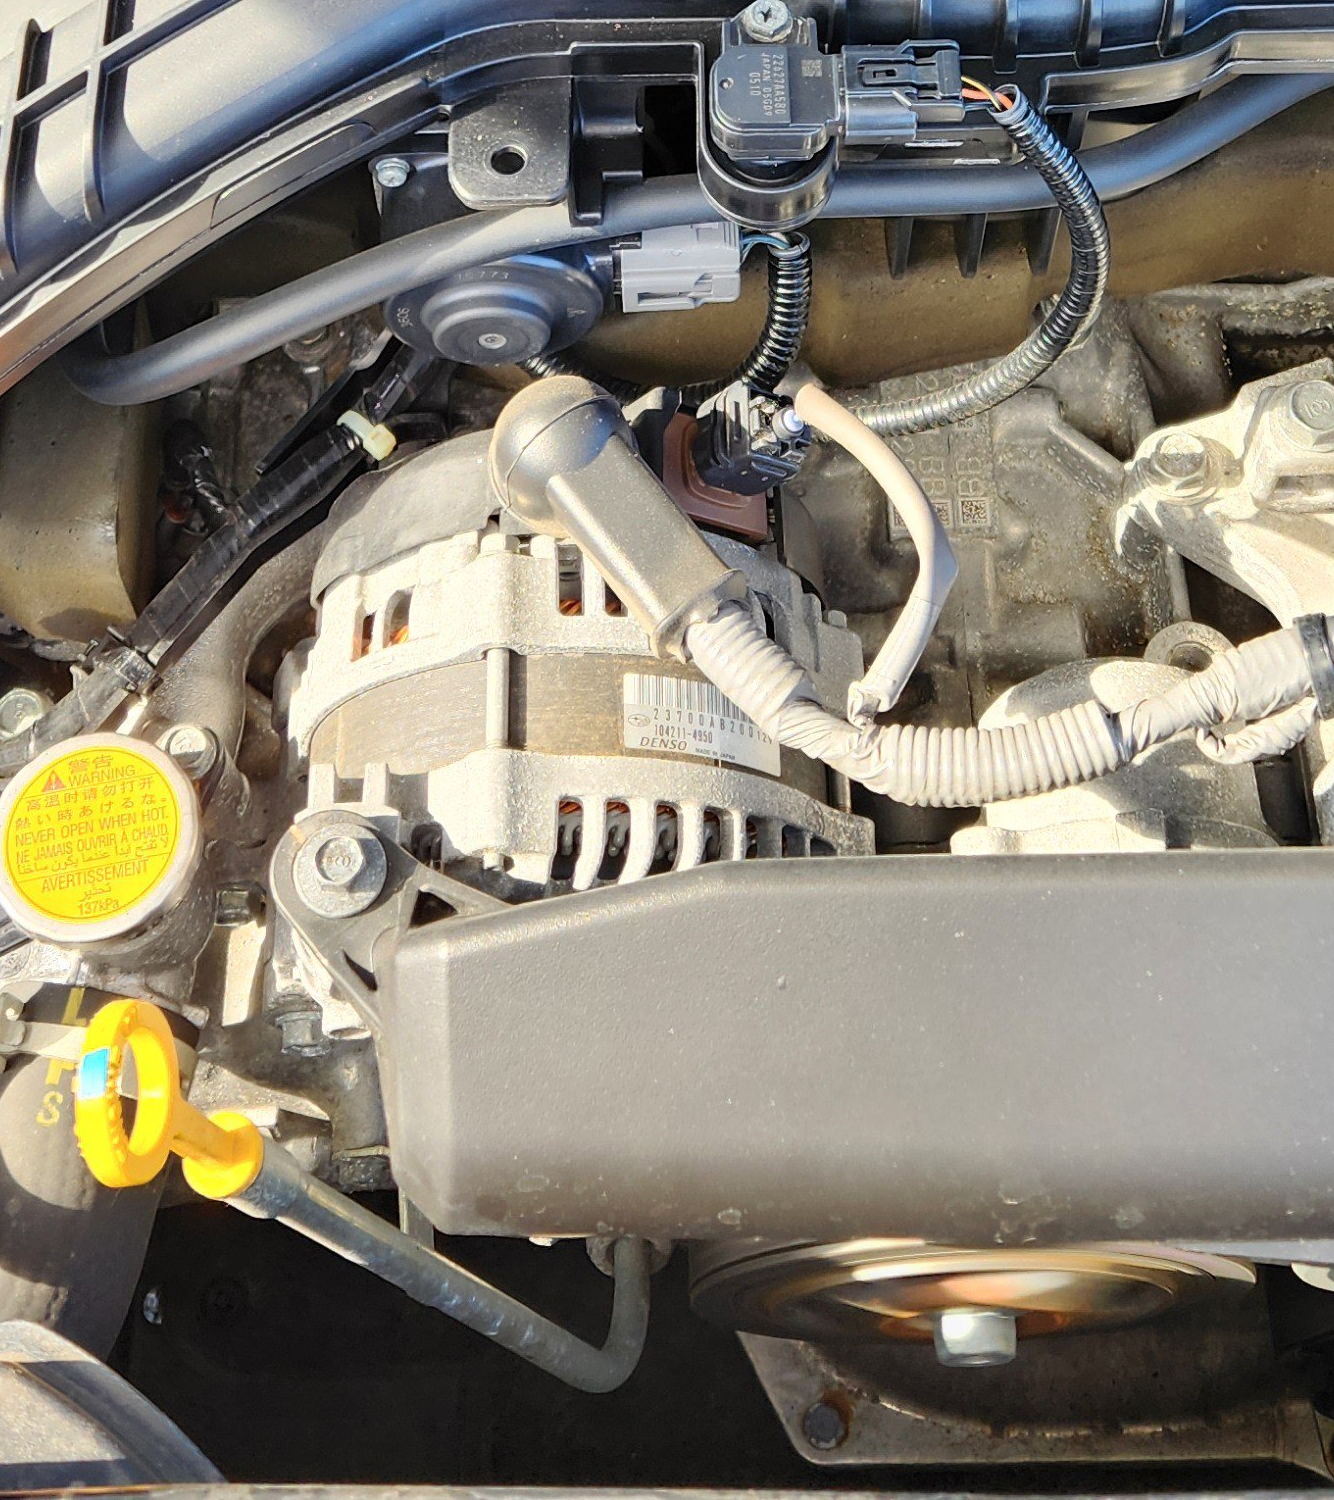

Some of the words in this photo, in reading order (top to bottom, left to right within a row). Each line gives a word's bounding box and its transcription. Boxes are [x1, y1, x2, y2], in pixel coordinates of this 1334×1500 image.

[761, 52, 771, 81] JAPAN
[640, 736, 688, 751] DENSO
[654, 723, 713, 744] 104211-4950
[68, 765, 136, 787] WARNING
[15, 827, 56, 847] NEVER
[60, 820, 94, 839] OPEN
[98, 812, 137, 833] WHEN
[141, 806, 169, 823] HOT.
[16, 849, 30, 865] NE
[34, 842, 73, 862] JAMAIS
[77, 833, 116, 851] OUVRIR
[41, 859, 149, 894] AVERTISSEMENT
[77, 898, 120, 916] 137kPa
